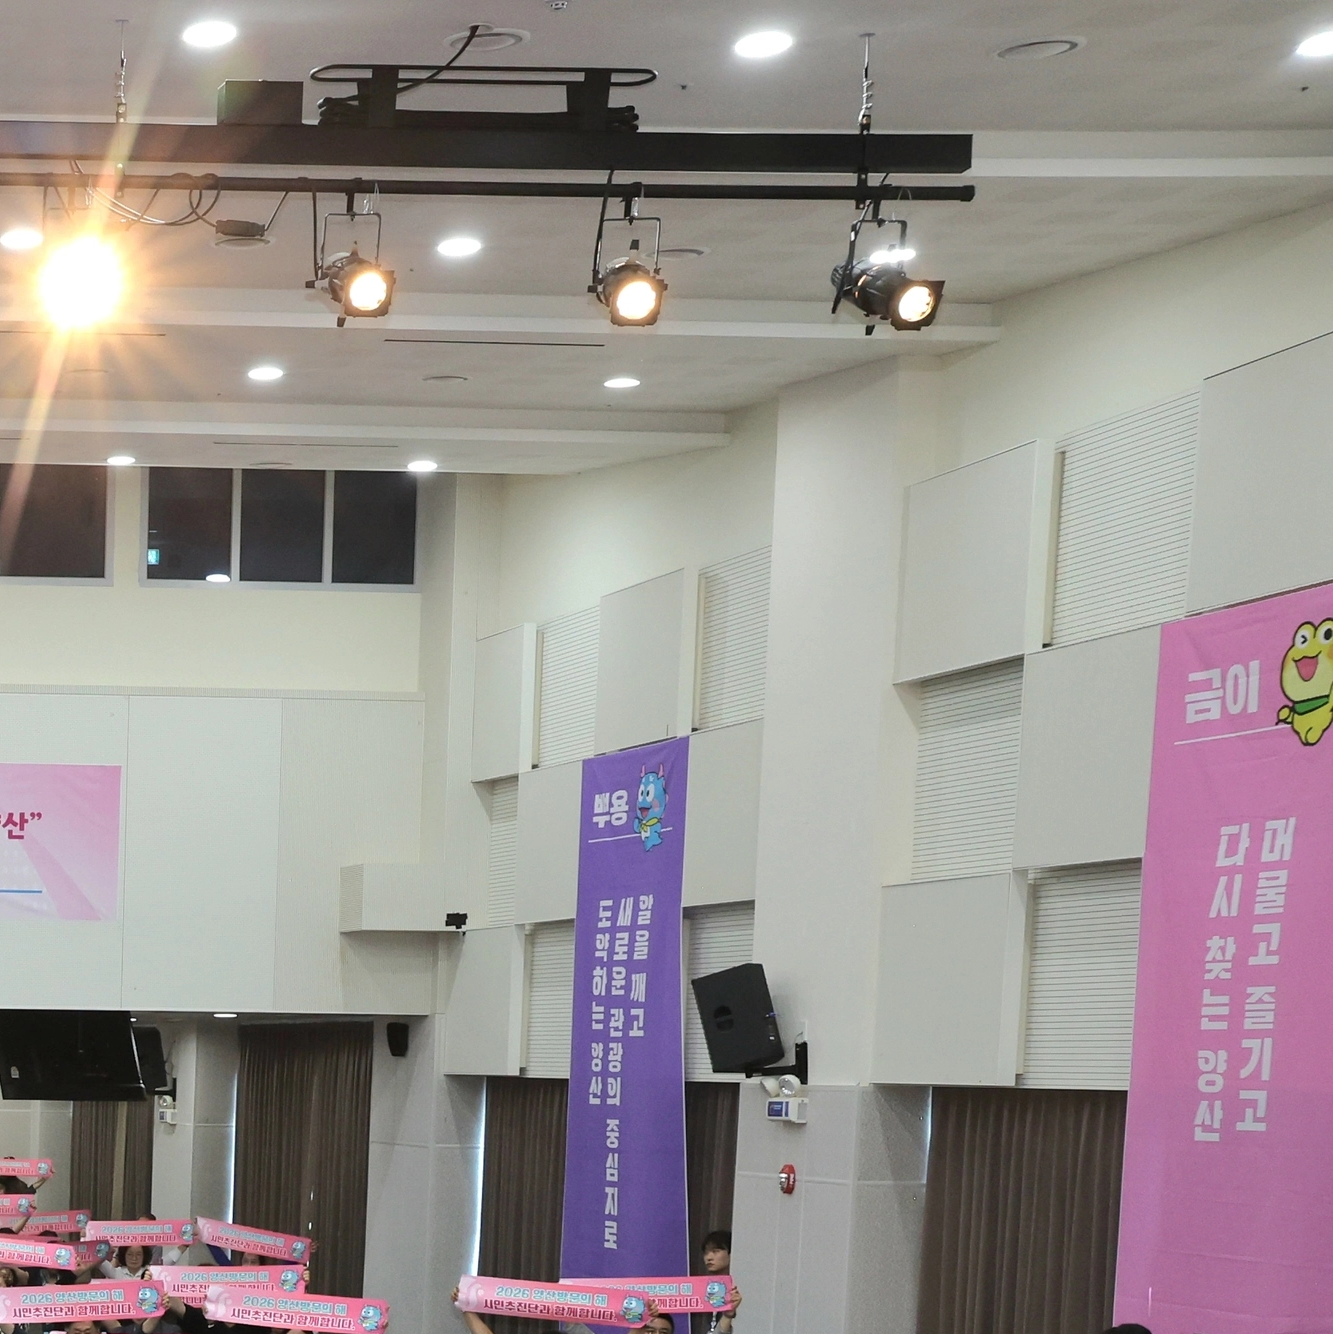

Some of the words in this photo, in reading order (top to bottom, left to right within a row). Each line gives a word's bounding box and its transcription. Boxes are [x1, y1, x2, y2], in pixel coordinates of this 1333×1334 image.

[1183, 667, 1260, 723] 금이
[1208, 823, 1251, 919] 다시
[1247, 817, 1296, 966] 머물고
[591, 900, 613, 1030] 도약하는
[611, 896, 633, 997] 새로운
[634, 894, 654, 960] 알을
[629, 972, 647, 1037] 깨고
[1200, 935, 1236, 1031] 찾는
[588, 1041, 604, 1105] 양산
[607, 1007, 625, 1107] 관광의
[1193, 1048, 1229, 1143] 양산
[1236, 985, 1276, 1133] 즐기고
[603, 1118, 621, 1249] 중심지로
